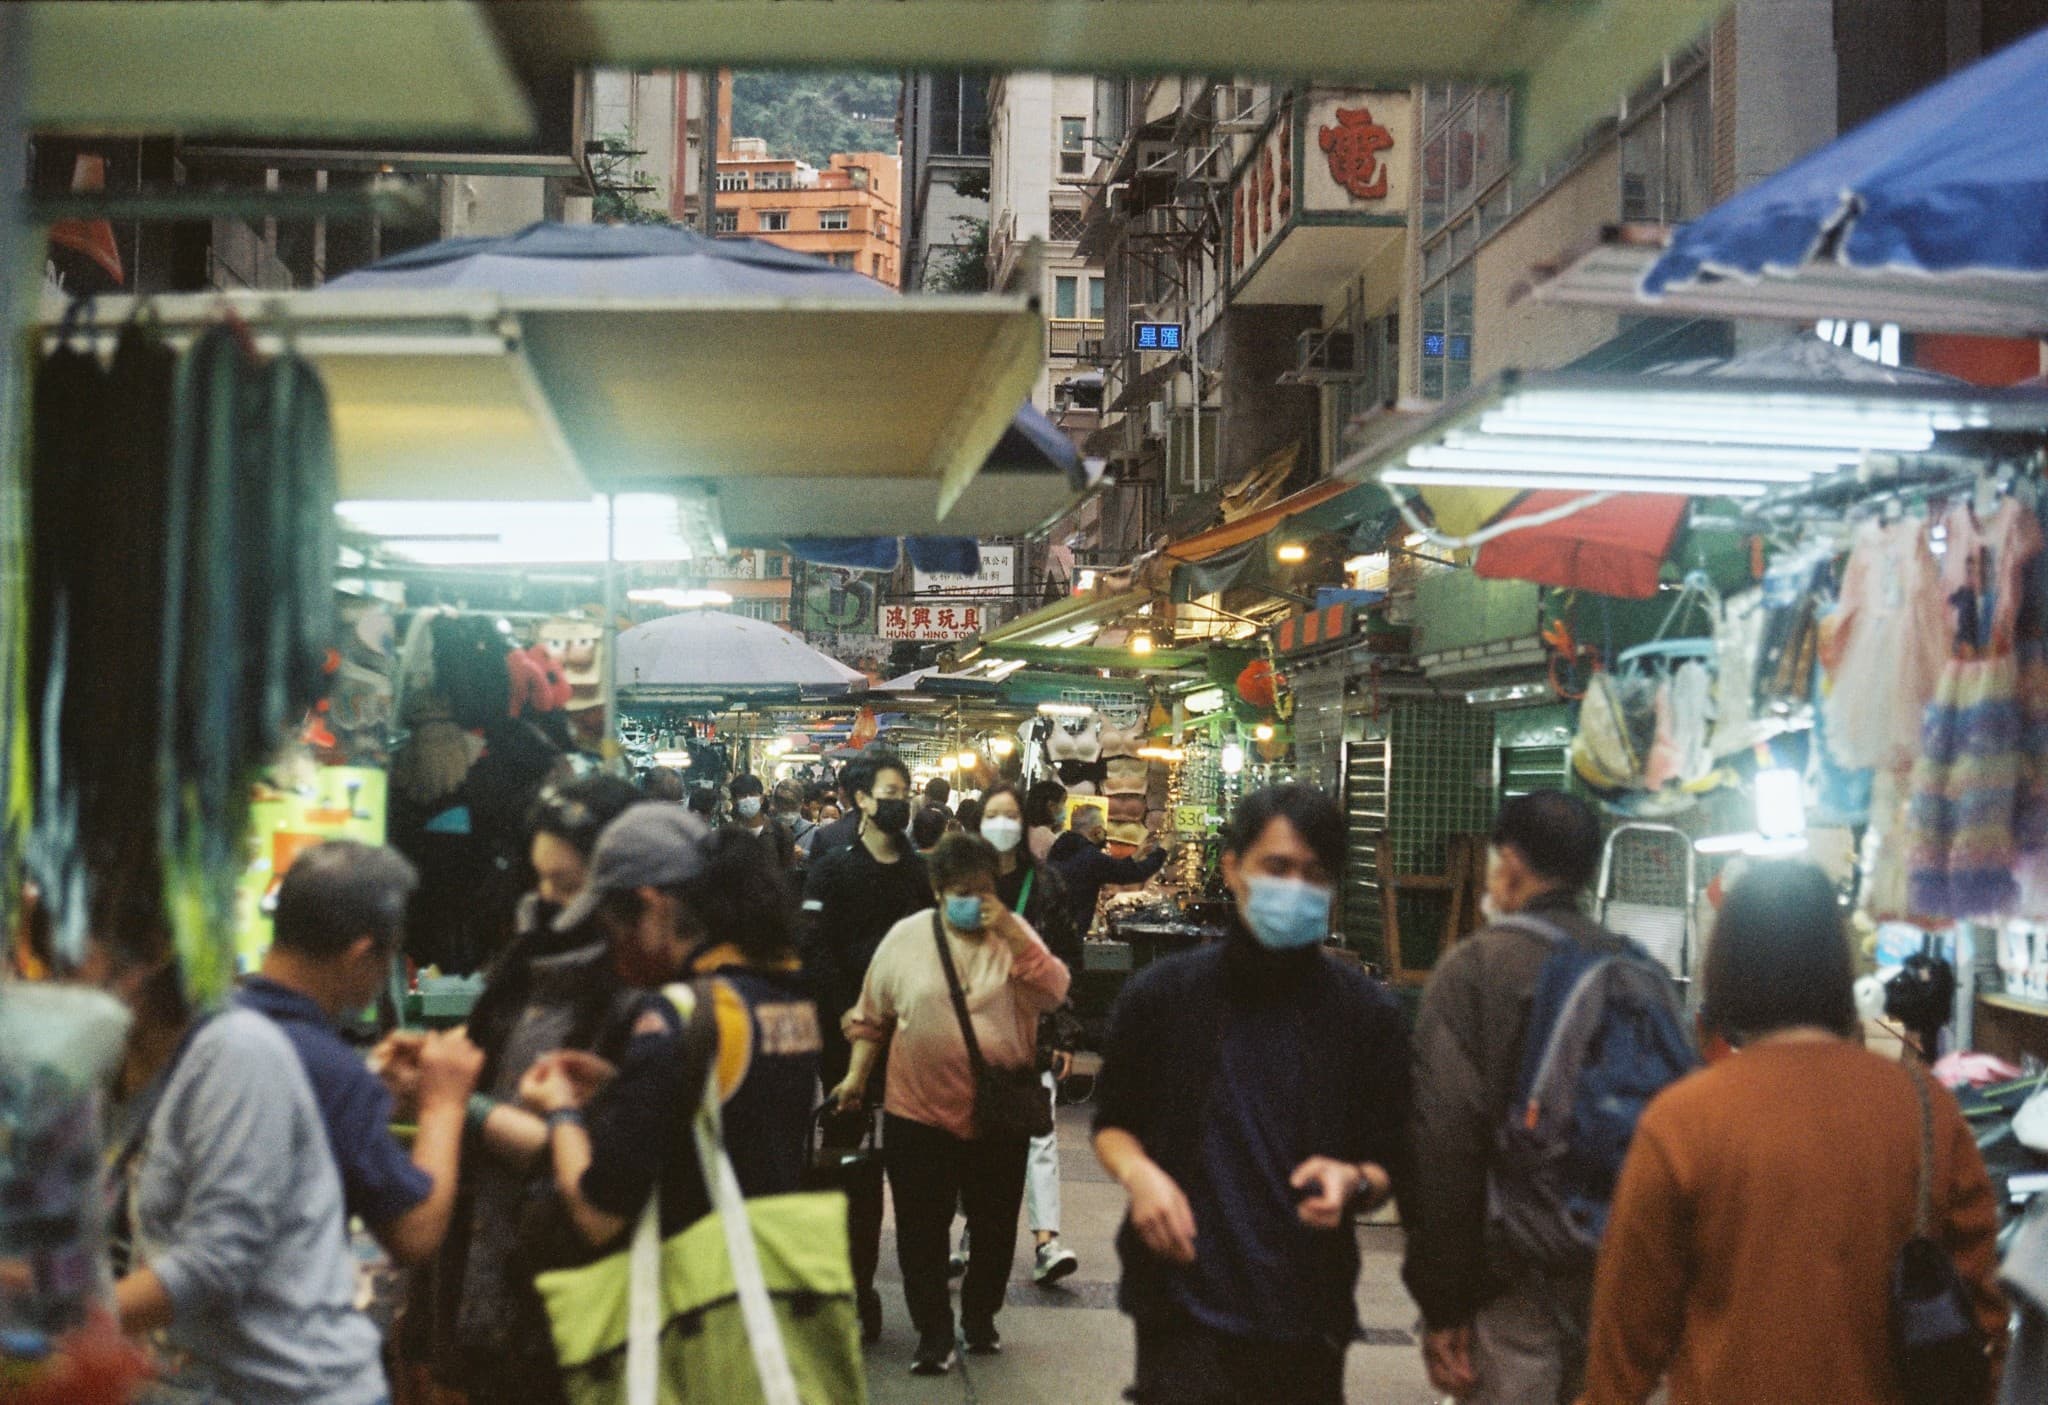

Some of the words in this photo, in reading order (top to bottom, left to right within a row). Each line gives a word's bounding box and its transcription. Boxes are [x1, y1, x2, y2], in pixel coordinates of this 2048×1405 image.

[1138, 326, 1179, 348] 星匯
[886, 605, 980, 630] 鴻興玩具
[886, 630, 916, 639] HUNG
[922, 630, 949, 639] HING
